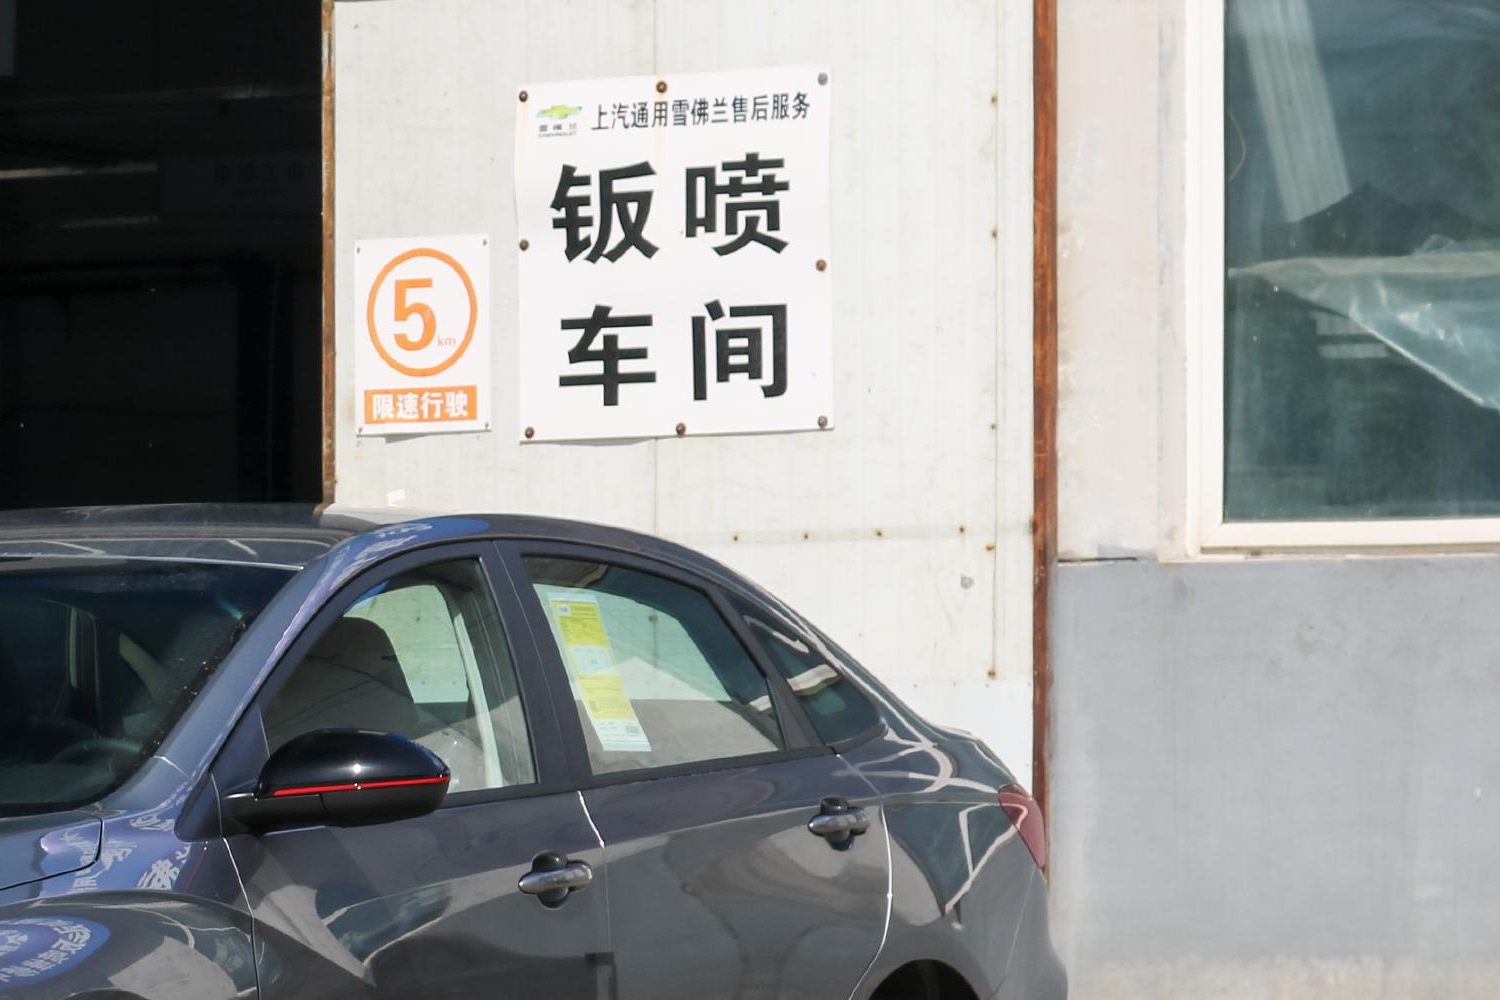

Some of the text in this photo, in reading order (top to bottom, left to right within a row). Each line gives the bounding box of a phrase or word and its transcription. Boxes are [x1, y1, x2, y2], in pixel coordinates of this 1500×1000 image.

[591, 91, 811, 131] 上汽通用雪佛兰售后服务
[550, 152, 790, 264] 钣喷
[393, 278, 457, 352] 5 km
[558, 299, 789, 407] 车间
[372, 390, 469, 420] 限速行驶
